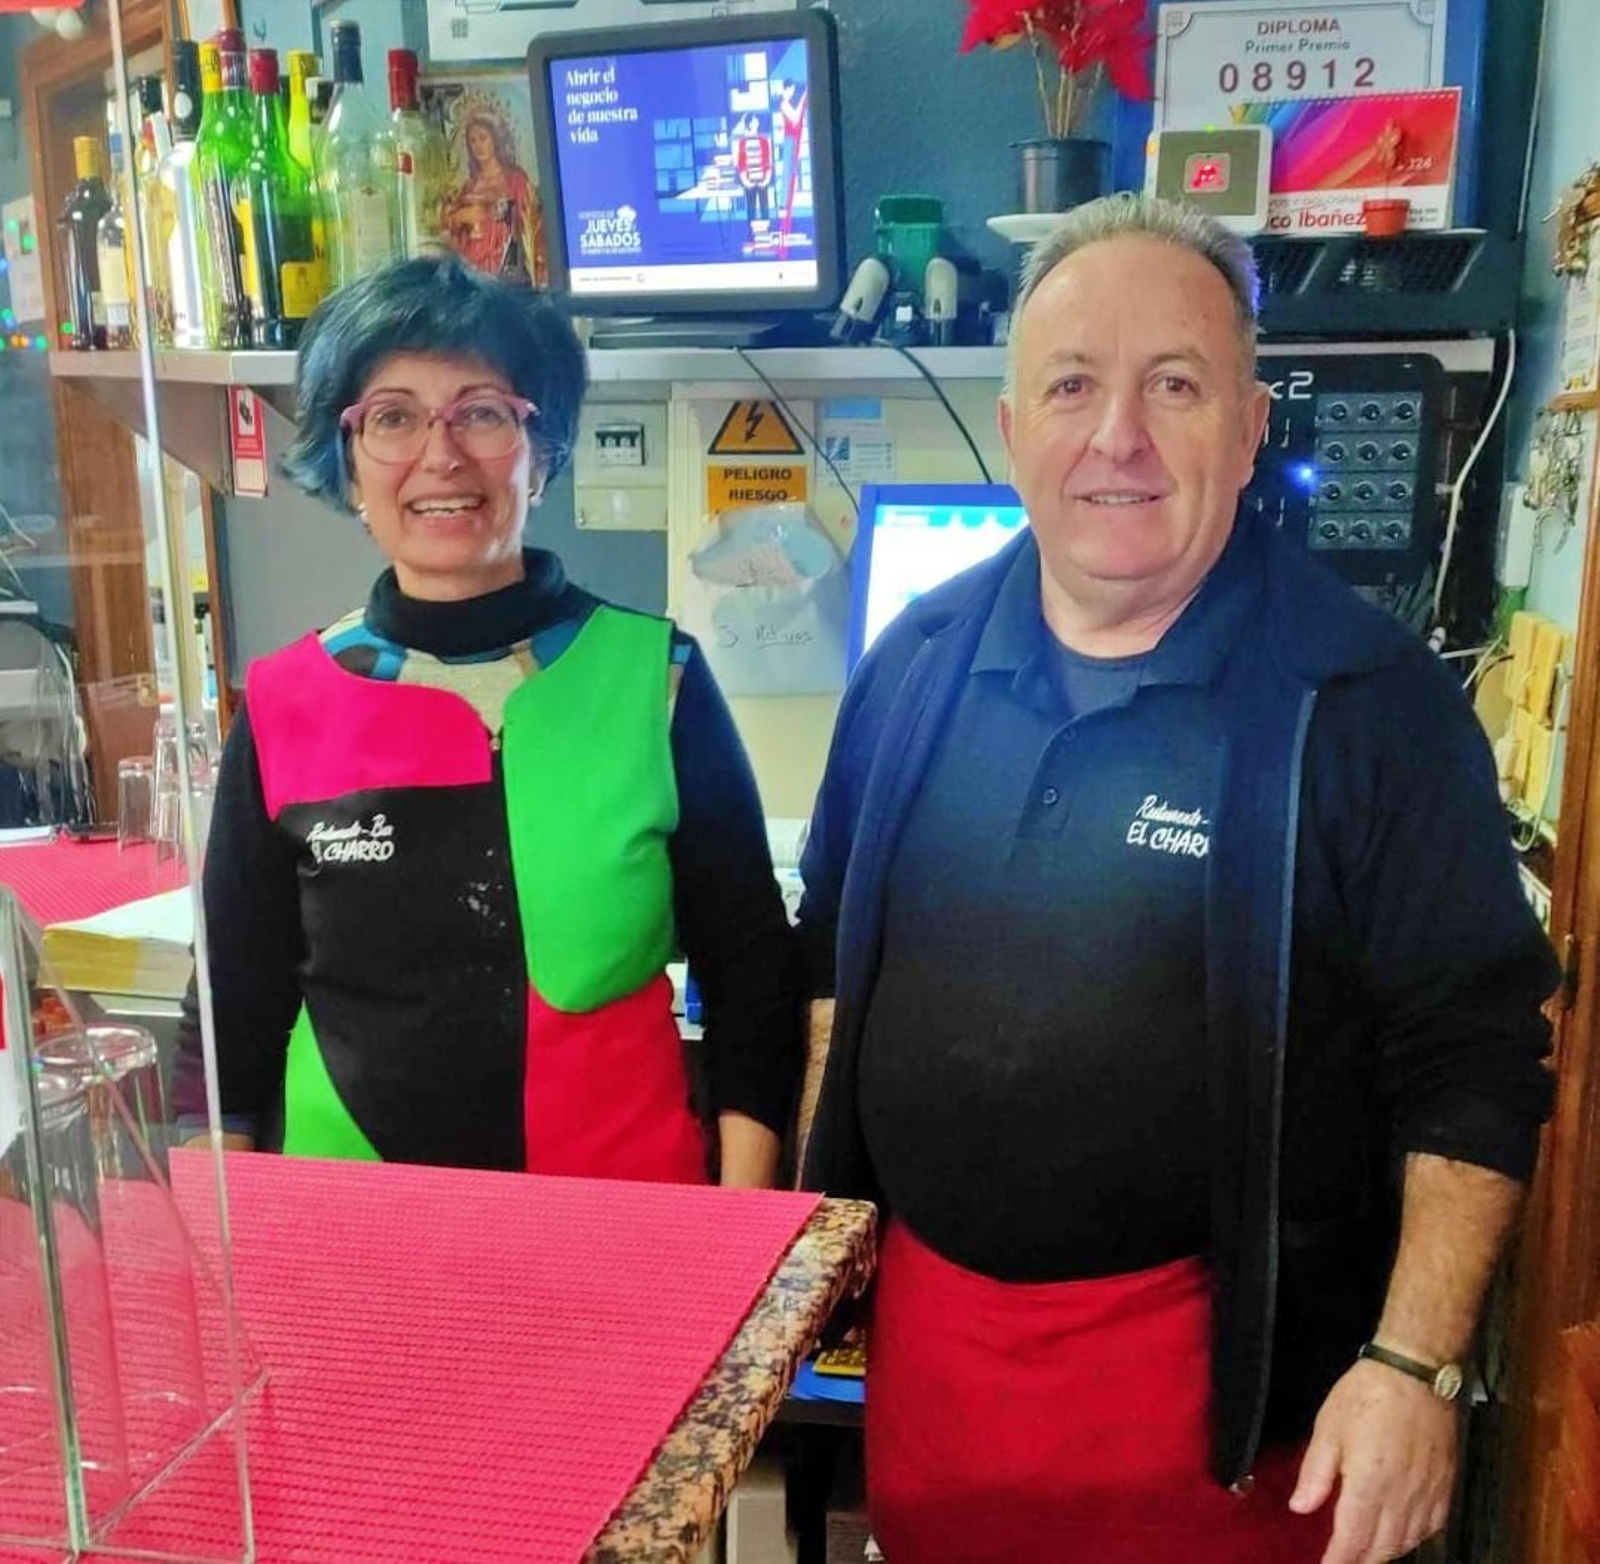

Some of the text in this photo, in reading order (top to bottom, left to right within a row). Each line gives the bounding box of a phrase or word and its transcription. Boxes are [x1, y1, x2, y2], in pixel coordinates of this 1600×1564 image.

[1257, 18, 1341, 35] DIPLOMA
[1245, 37, 1350, 53] Primer Premio
[565, 65, 615, 87] Abrir el
[566, 86, 618, 108] negocio
[568, 106, 638, 124] de nuestra
[570, 127, 598, 143] vida
[585, 217, 631, 234] JUEVES
[723, 467, 793, 481] PELIGRO
[728, 488, 788, 502] RIESGO
[323, 838, 394, 863] CHARRO
